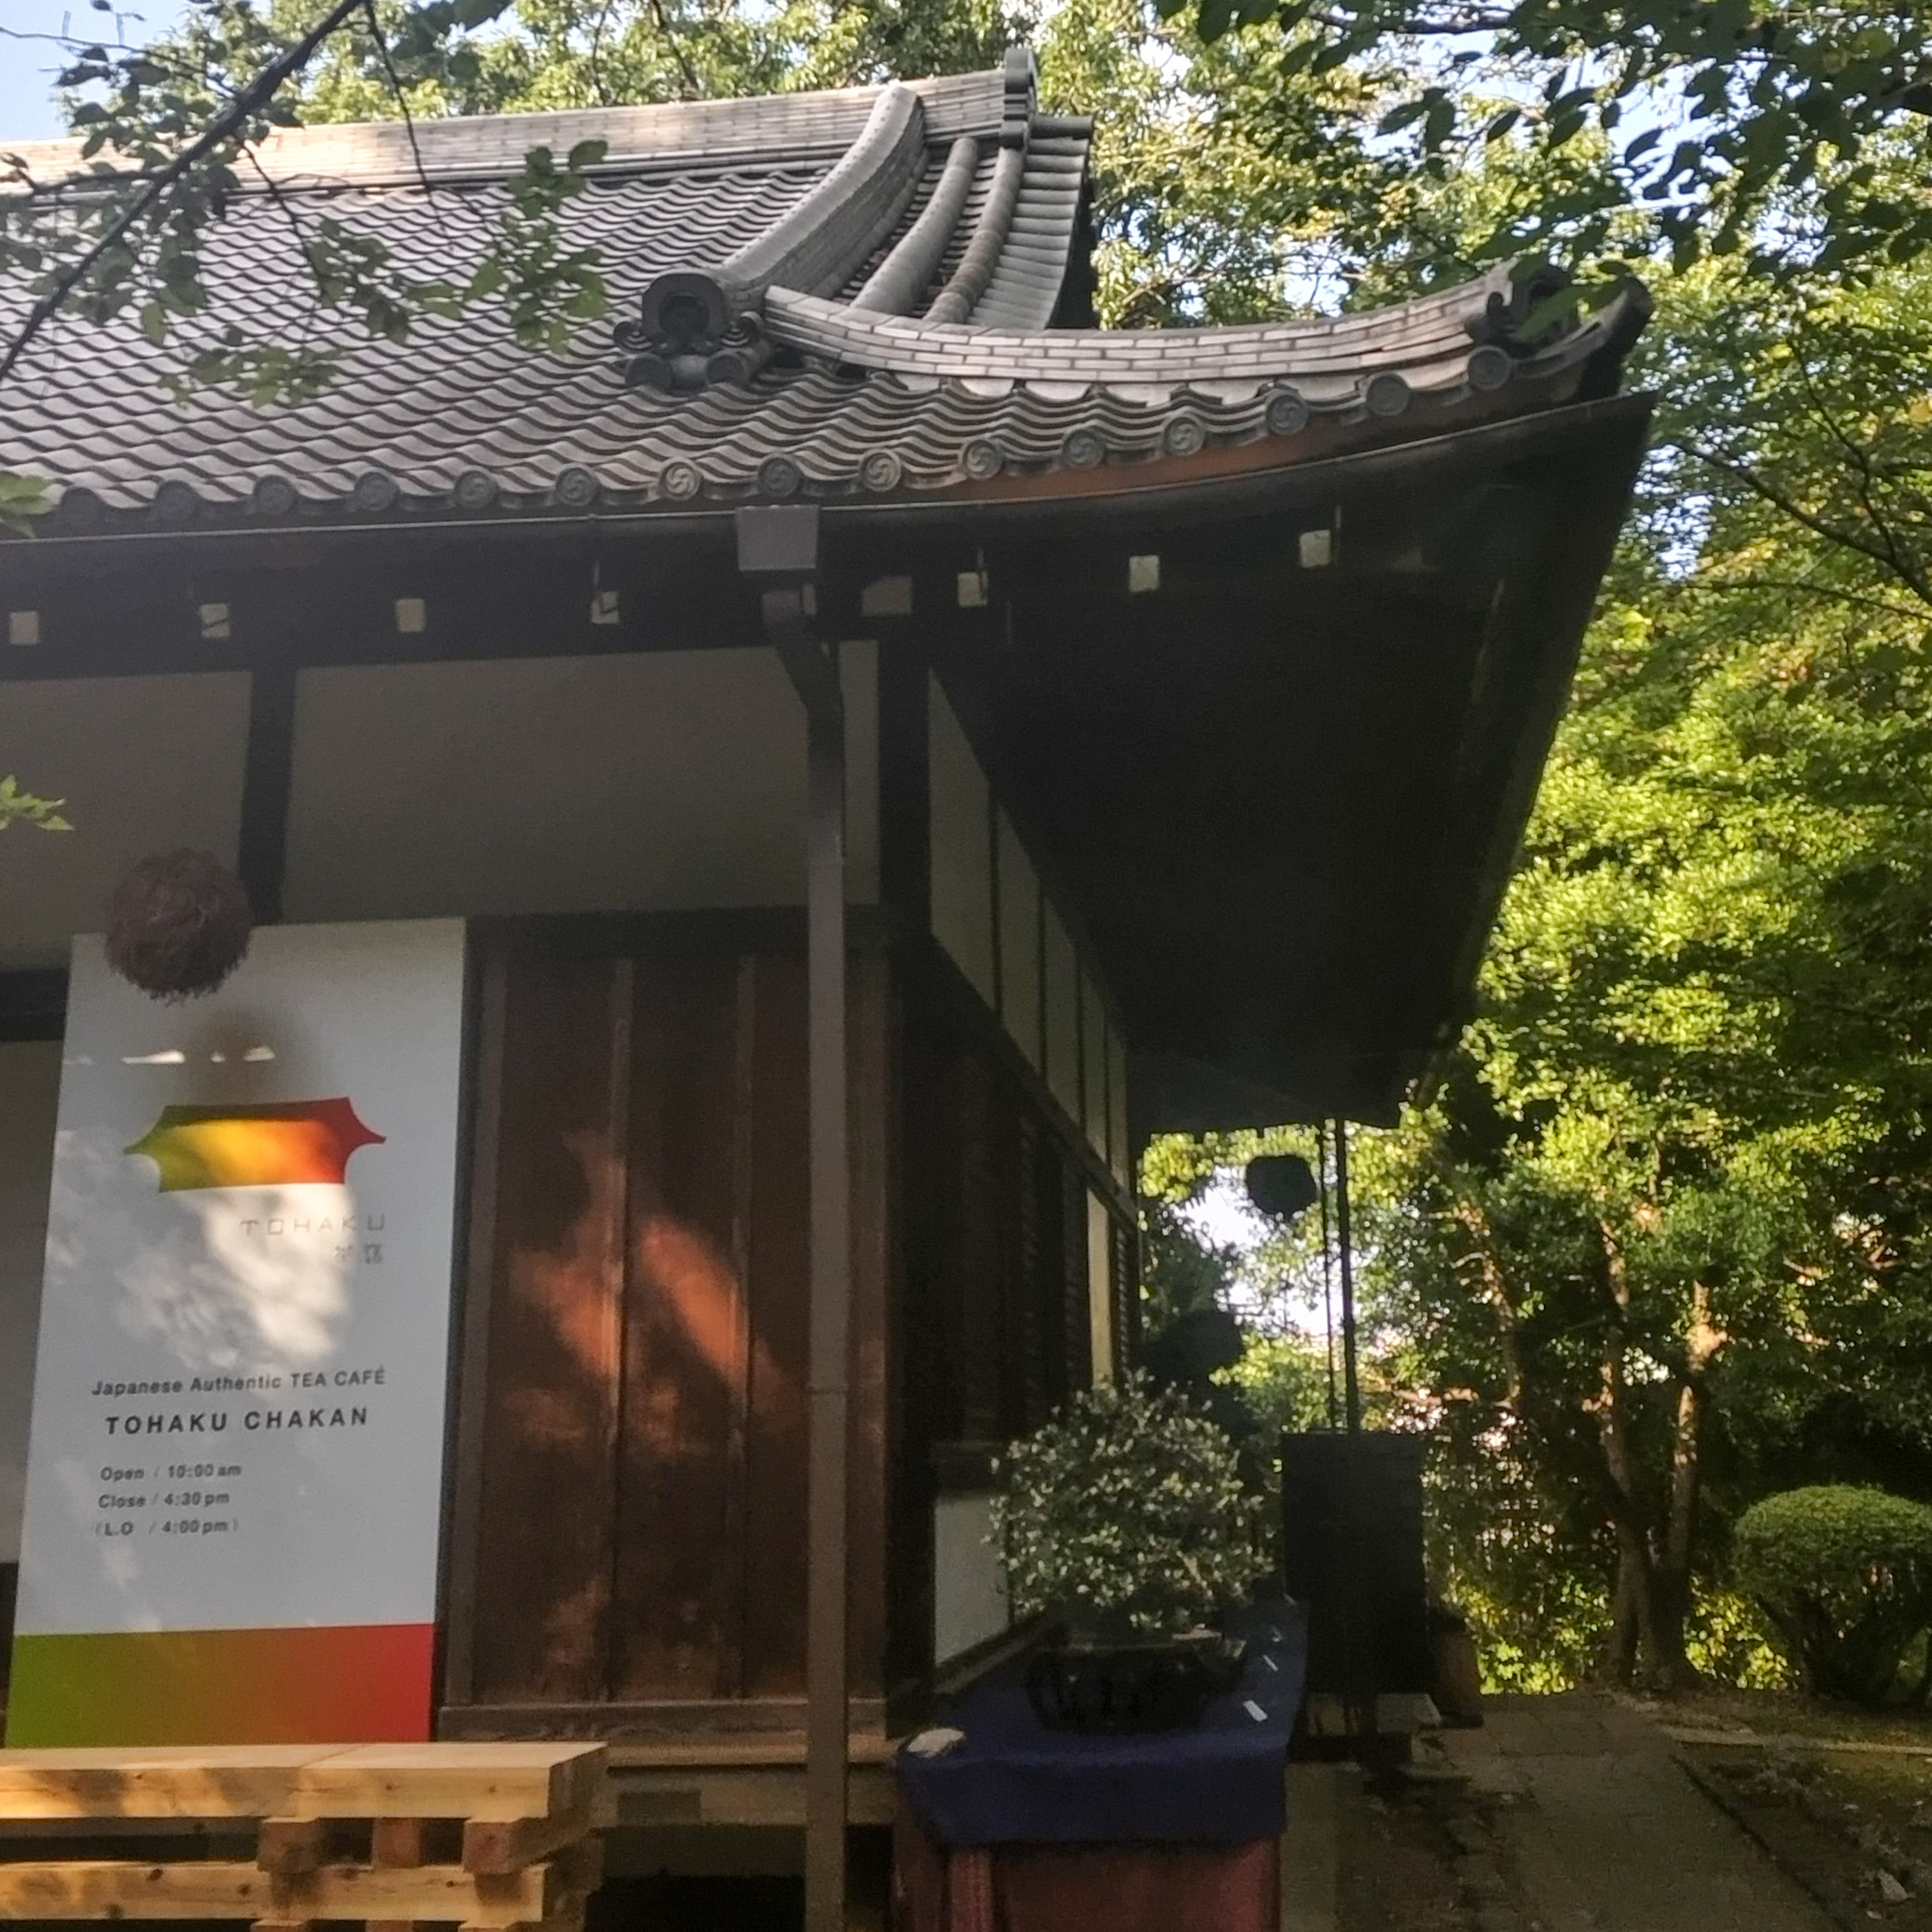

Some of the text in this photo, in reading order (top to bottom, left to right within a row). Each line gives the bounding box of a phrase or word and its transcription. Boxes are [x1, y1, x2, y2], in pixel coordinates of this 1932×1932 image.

[240, 1214, 386, 1235] TOHAKU
[91, 1364, 386, 1398] Japanese Authentic TEA CAFÉ
[105, 1407, 368, 1435] TOHAKU CHAKAN
[100, 1466, 145, 1481] Open
[98, 1494, 146, 1509] Close
